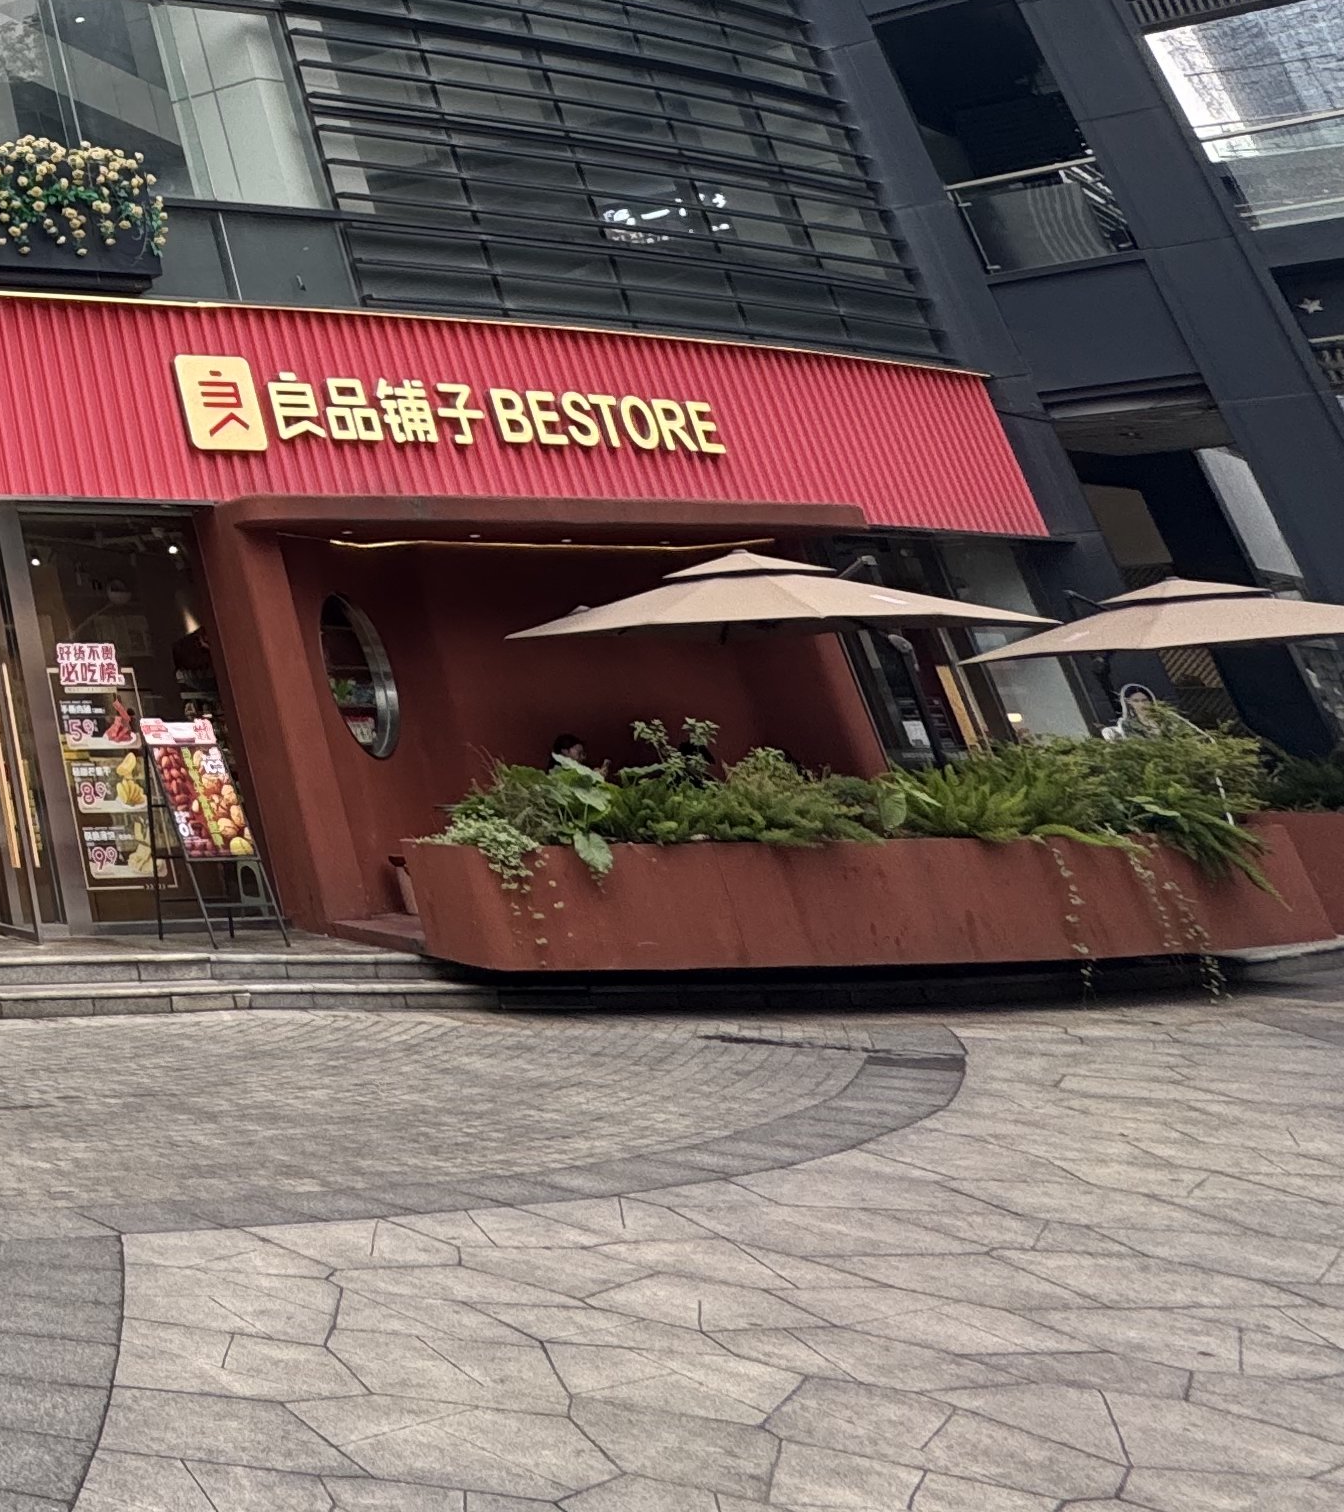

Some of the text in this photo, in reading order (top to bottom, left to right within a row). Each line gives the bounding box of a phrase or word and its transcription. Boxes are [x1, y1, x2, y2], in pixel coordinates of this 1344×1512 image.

[267, 371, 727, 455] 良品铺子 BESTORE
